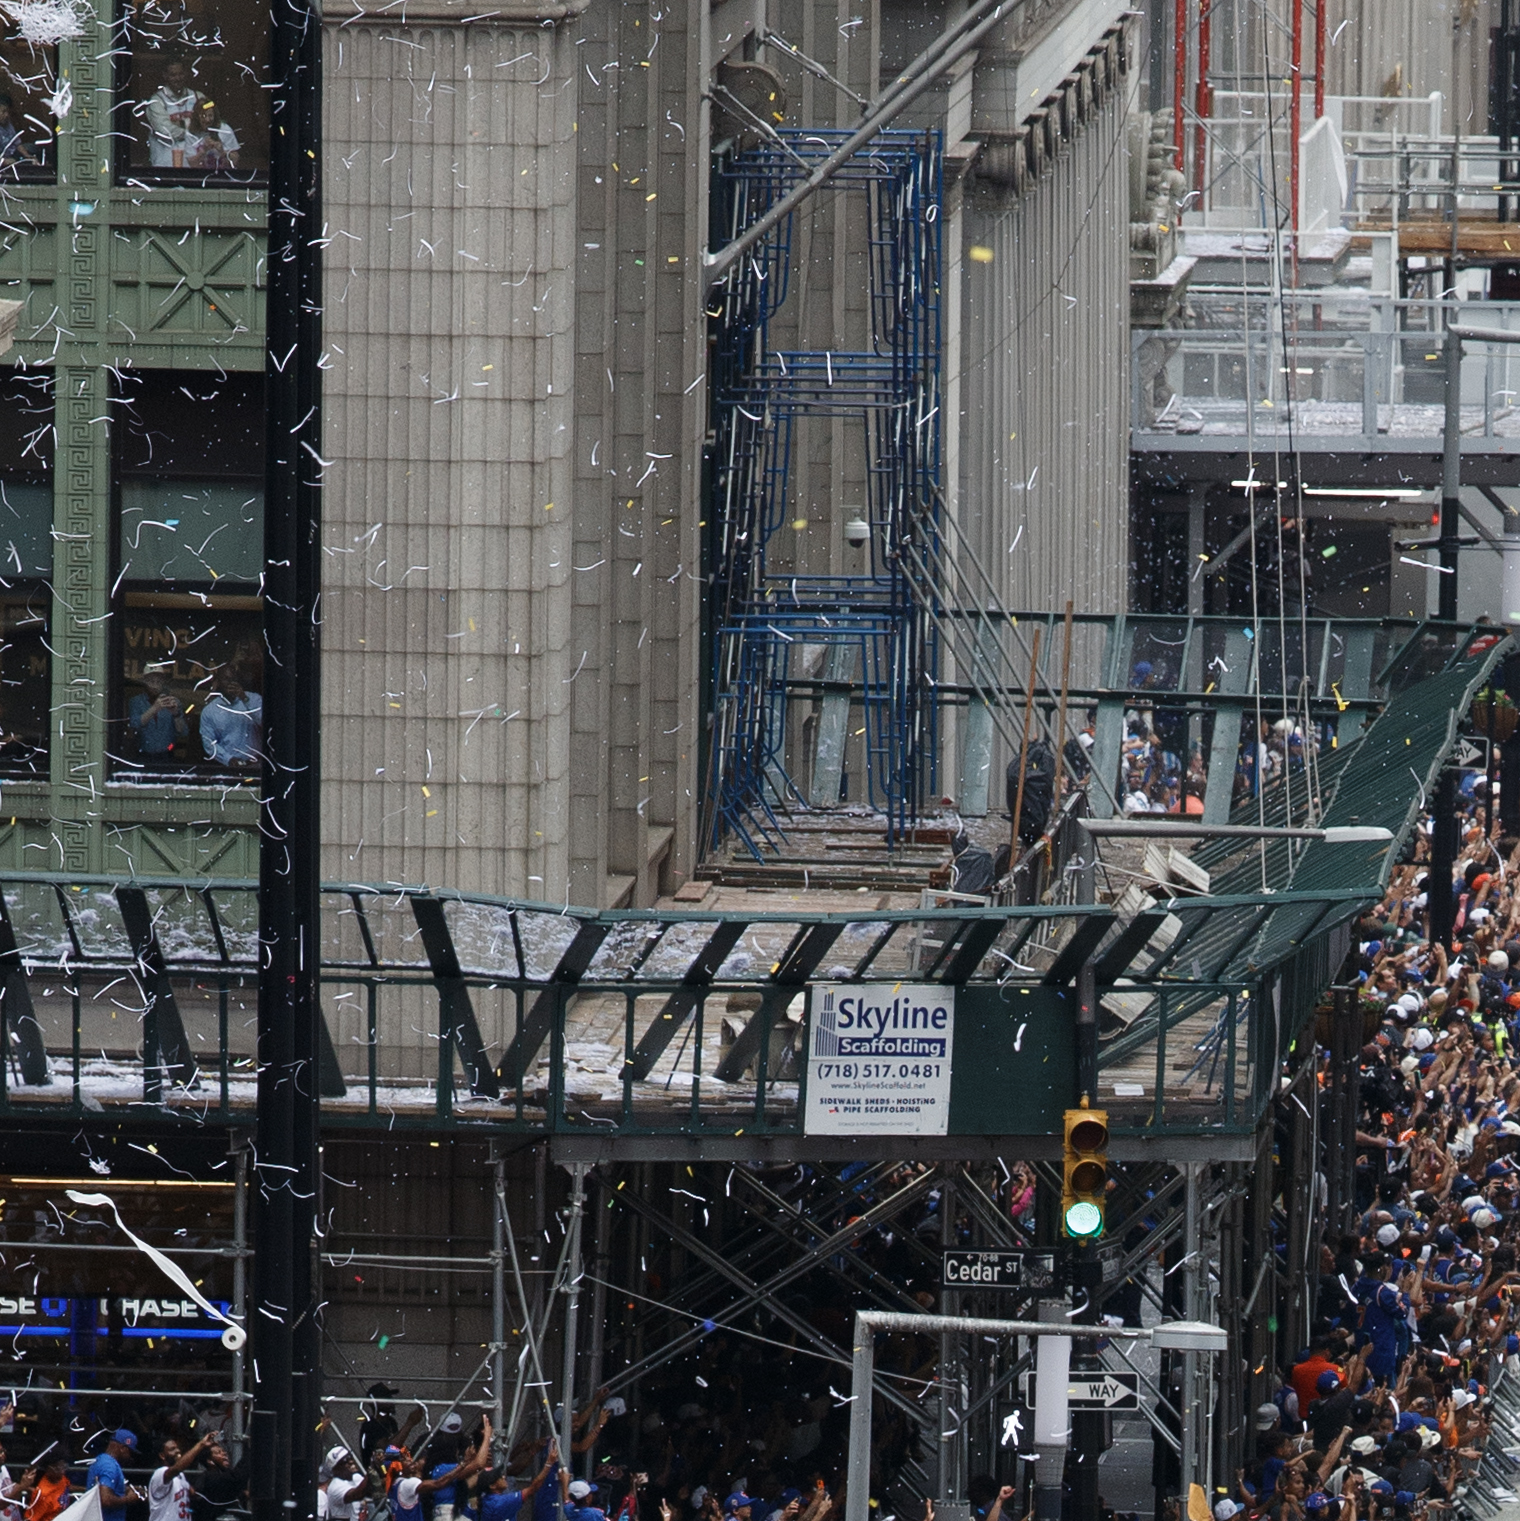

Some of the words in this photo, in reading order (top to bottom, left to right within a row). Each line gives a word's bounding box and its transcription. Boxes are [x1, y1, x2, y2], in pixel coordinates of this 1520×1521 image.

[838, 997, 948, 1039] Skyline
[841, 1038, 941, 1056] Scaffolding
[819, 1097, 862, 1105] SIDEWALK
[864, 1097, 891, 1106] SHEDS
[896, 1097, 936, 1105] HOISTING
[843, 1106, 861, 1114] PIPE
[864, 1106, 921, 1114] SCAFFOLDING
[946, 1259, 1002, 1282] Cedar
[1005, 1262, 1018, 1275] ST
[1089, 1384, 1119, 1398] WAY
